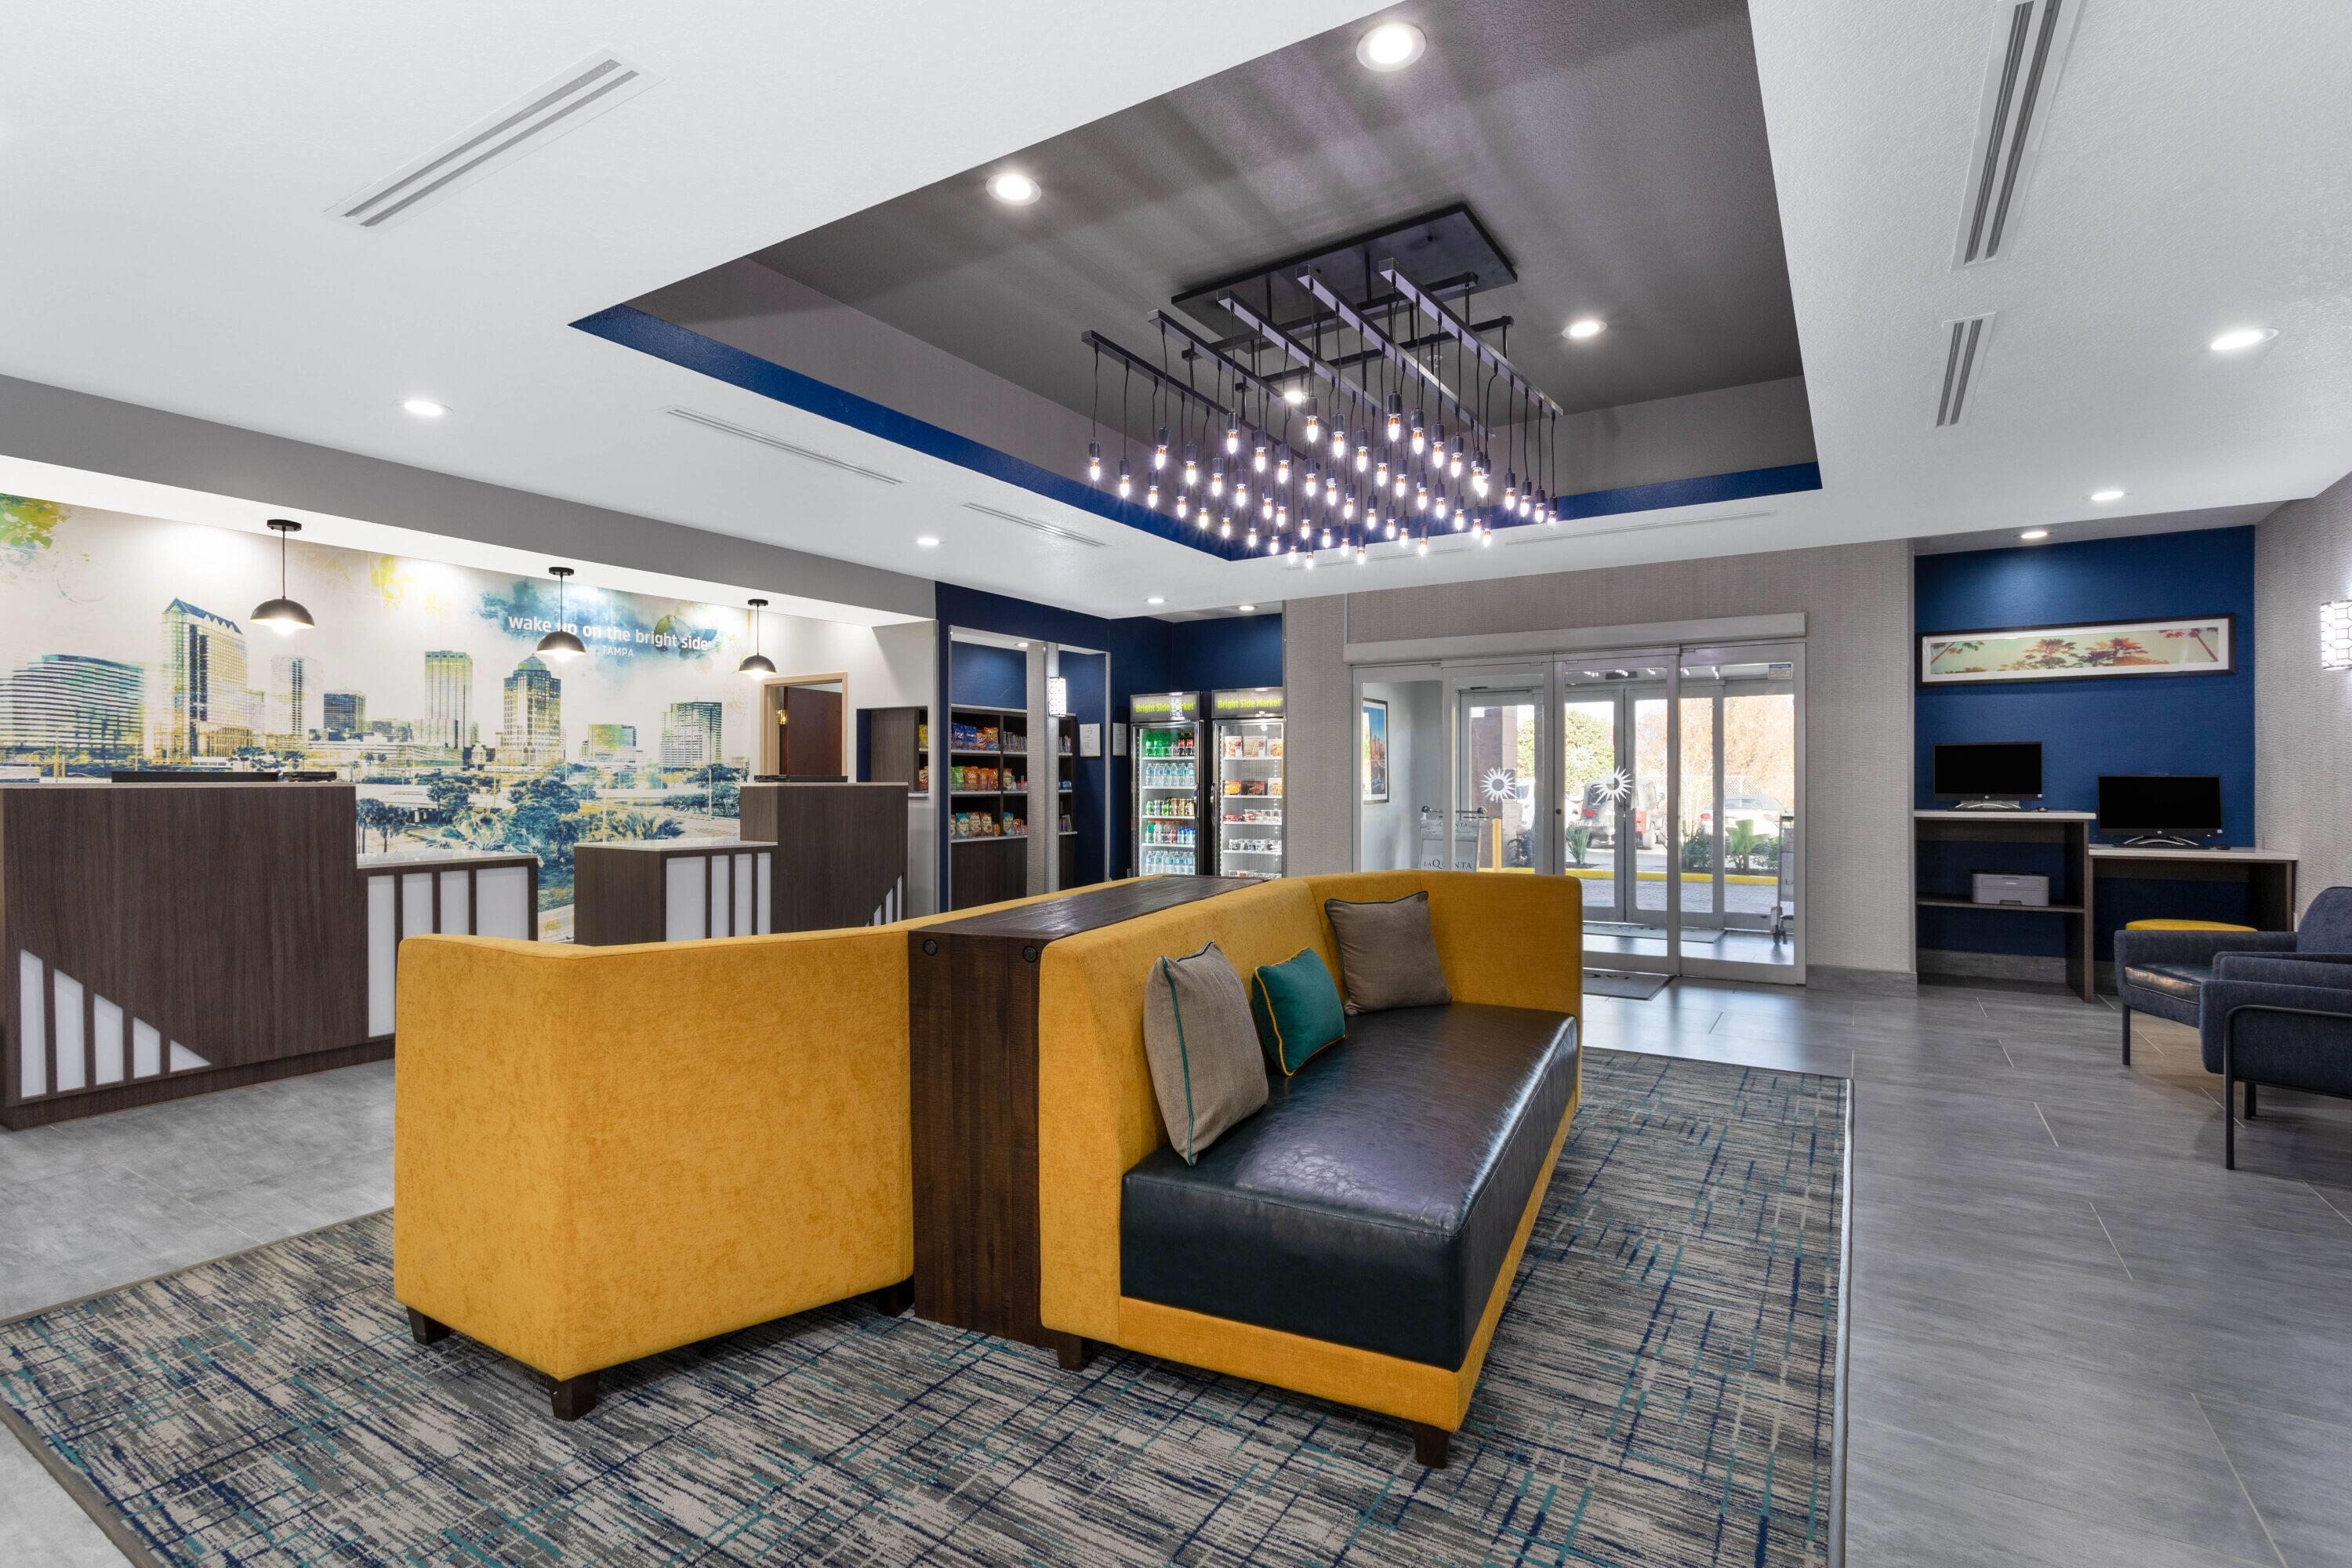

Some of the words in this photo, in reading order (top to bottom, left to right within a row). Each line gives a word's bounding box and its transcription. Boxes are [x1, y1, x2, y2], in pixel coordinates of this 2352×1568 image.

[508, 615, 552, 633] wake
[583, 625, 602, 639] on
[608, 626, 630, 641] the
[636, 629, 677, 648] bright
[602, 645, 634, 658] TAMPA
[1134, 703, 1155, 713] Bright
[1156, 702, 1171, 712] Side
[1217, 699, 1238, 710] Bright
[1240, 699, 1254, 708] Side
[1256, 699, 1281, 707] Market
